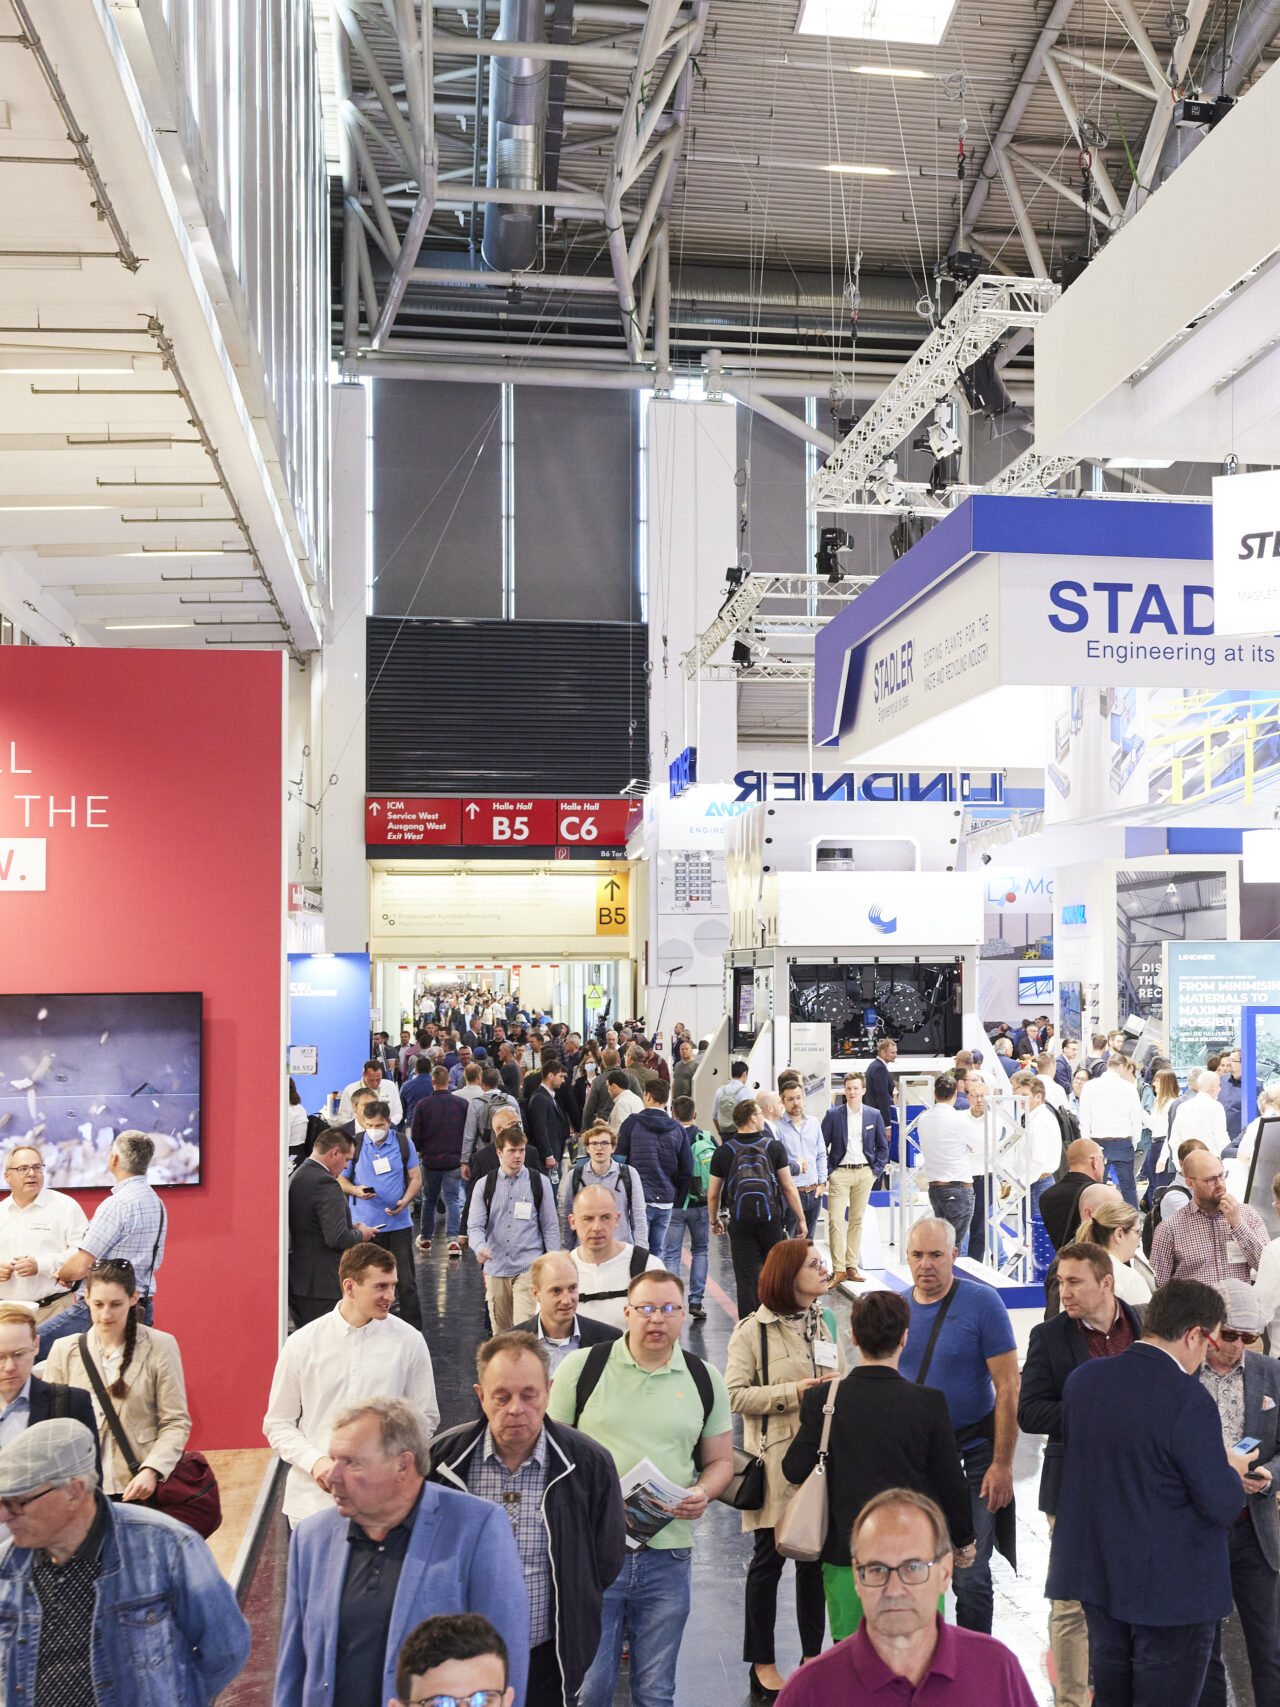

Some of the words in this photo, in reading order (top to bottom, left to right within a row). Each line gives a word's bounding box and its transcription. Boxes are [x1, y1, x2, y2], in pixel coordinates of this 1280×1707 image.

[1087, 640, 1215, 665] Engineering
[1224, 646, 1244, 662] at
[1252, 642, 1275, 663] its
[874, 639, 914, 704] STADLER
[387, 801, 404, 809] ICM
[493, 802, 514, 810] Halle
[516, 802, 533, 810] Hall
[561, 802, 581, 810] Halle
[583, 802, 600, 810] Hall
[13, 795, 109, 828] THE
[387, 812, 416, 820] Service
[387, 822, 424, 831] Ausgang
[426, 822, 447, 830] West
[492, 816, 530, 840] B5
[560, 816, 598, 841] C6
[387, 832, 402, 840] Exit
[404, 832, 424, 840] West
[599, 907, 626, 925] B5
[1179, 981, 1215, 992] FROM
[1179, 993, 1249, 1003] MATERIALS
[1251, 992, 1268, 1002] TO
